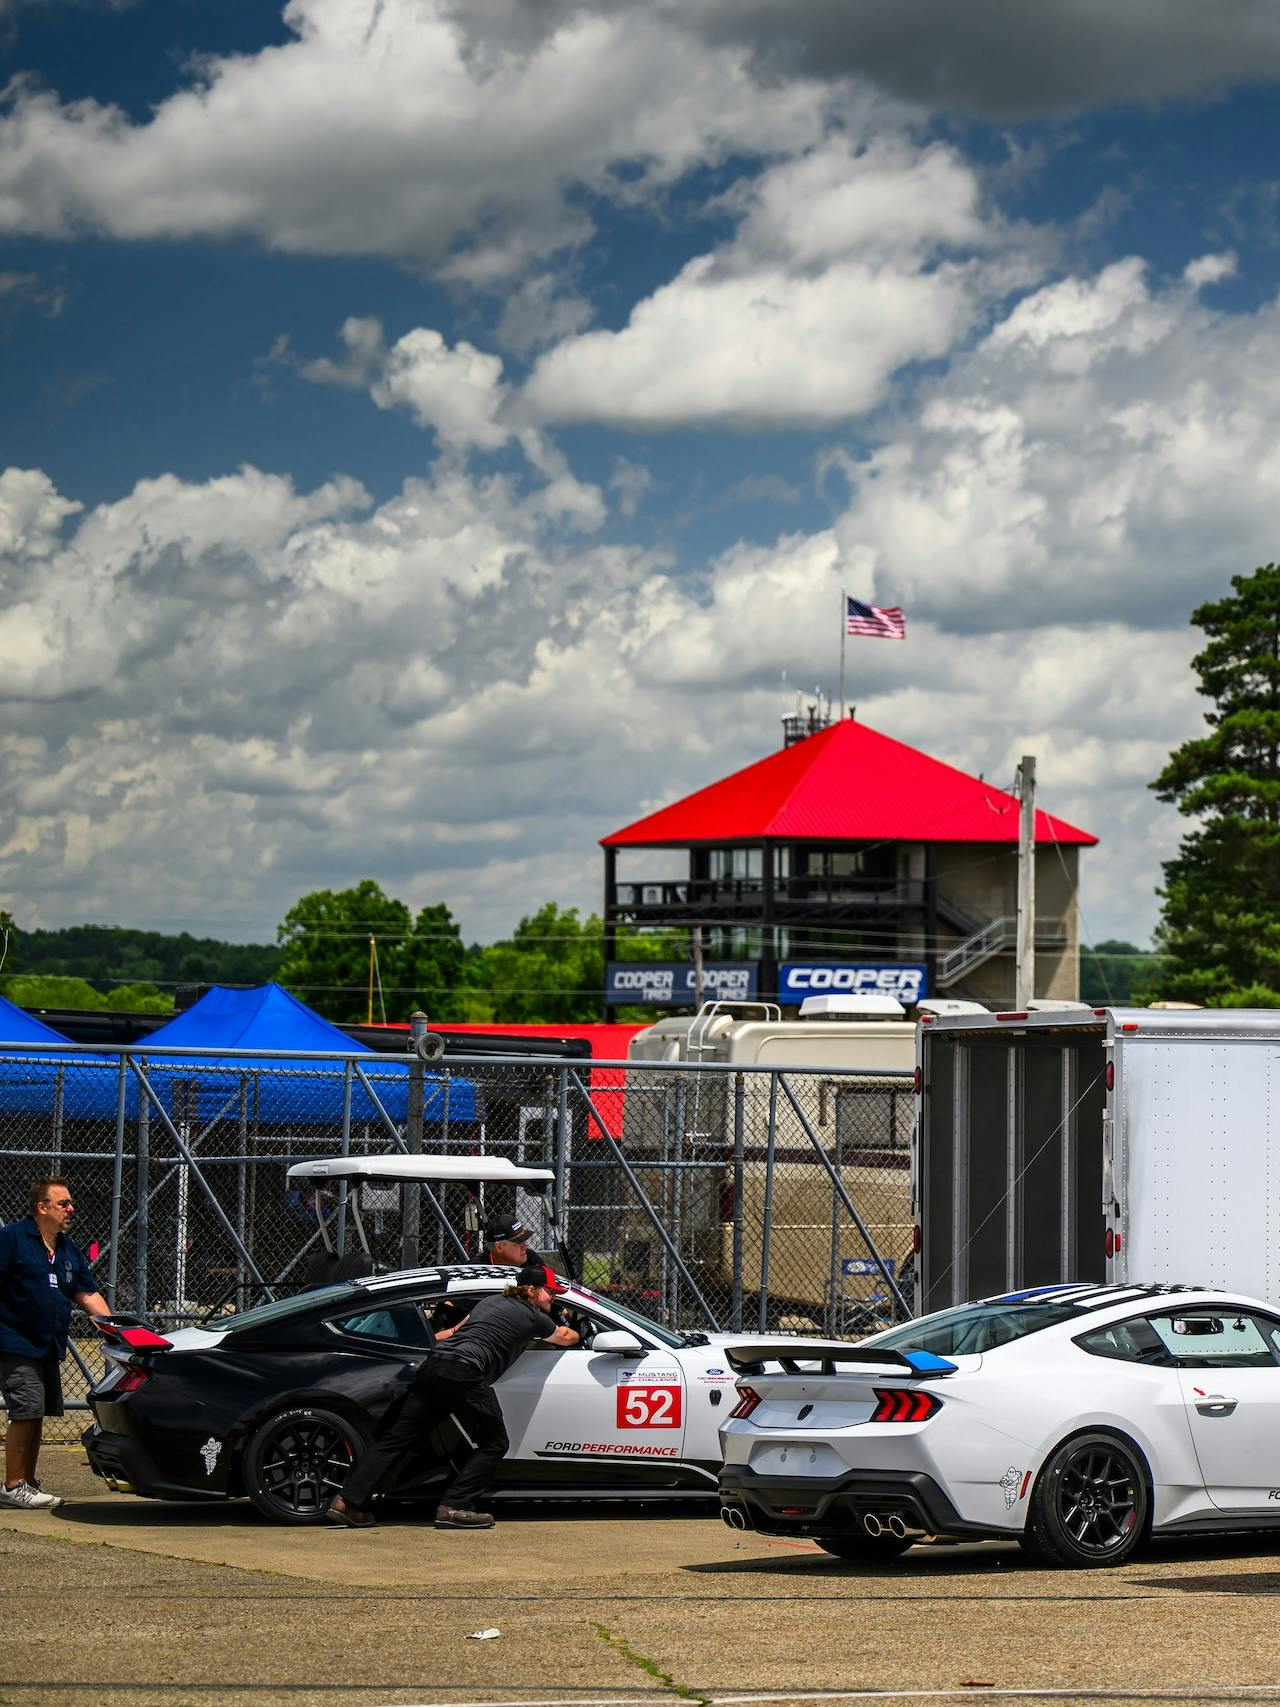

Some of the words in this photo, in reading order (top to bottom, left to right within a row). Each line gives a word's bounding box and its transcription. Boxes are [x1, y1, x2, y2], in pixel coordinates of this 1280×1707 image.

[613, 971, 674, 989] COOPER
[686, 970, 749, 988] COOPER
[787, 968, 923, 989] COOPER
[625, 1389, 674, 1425] 52
